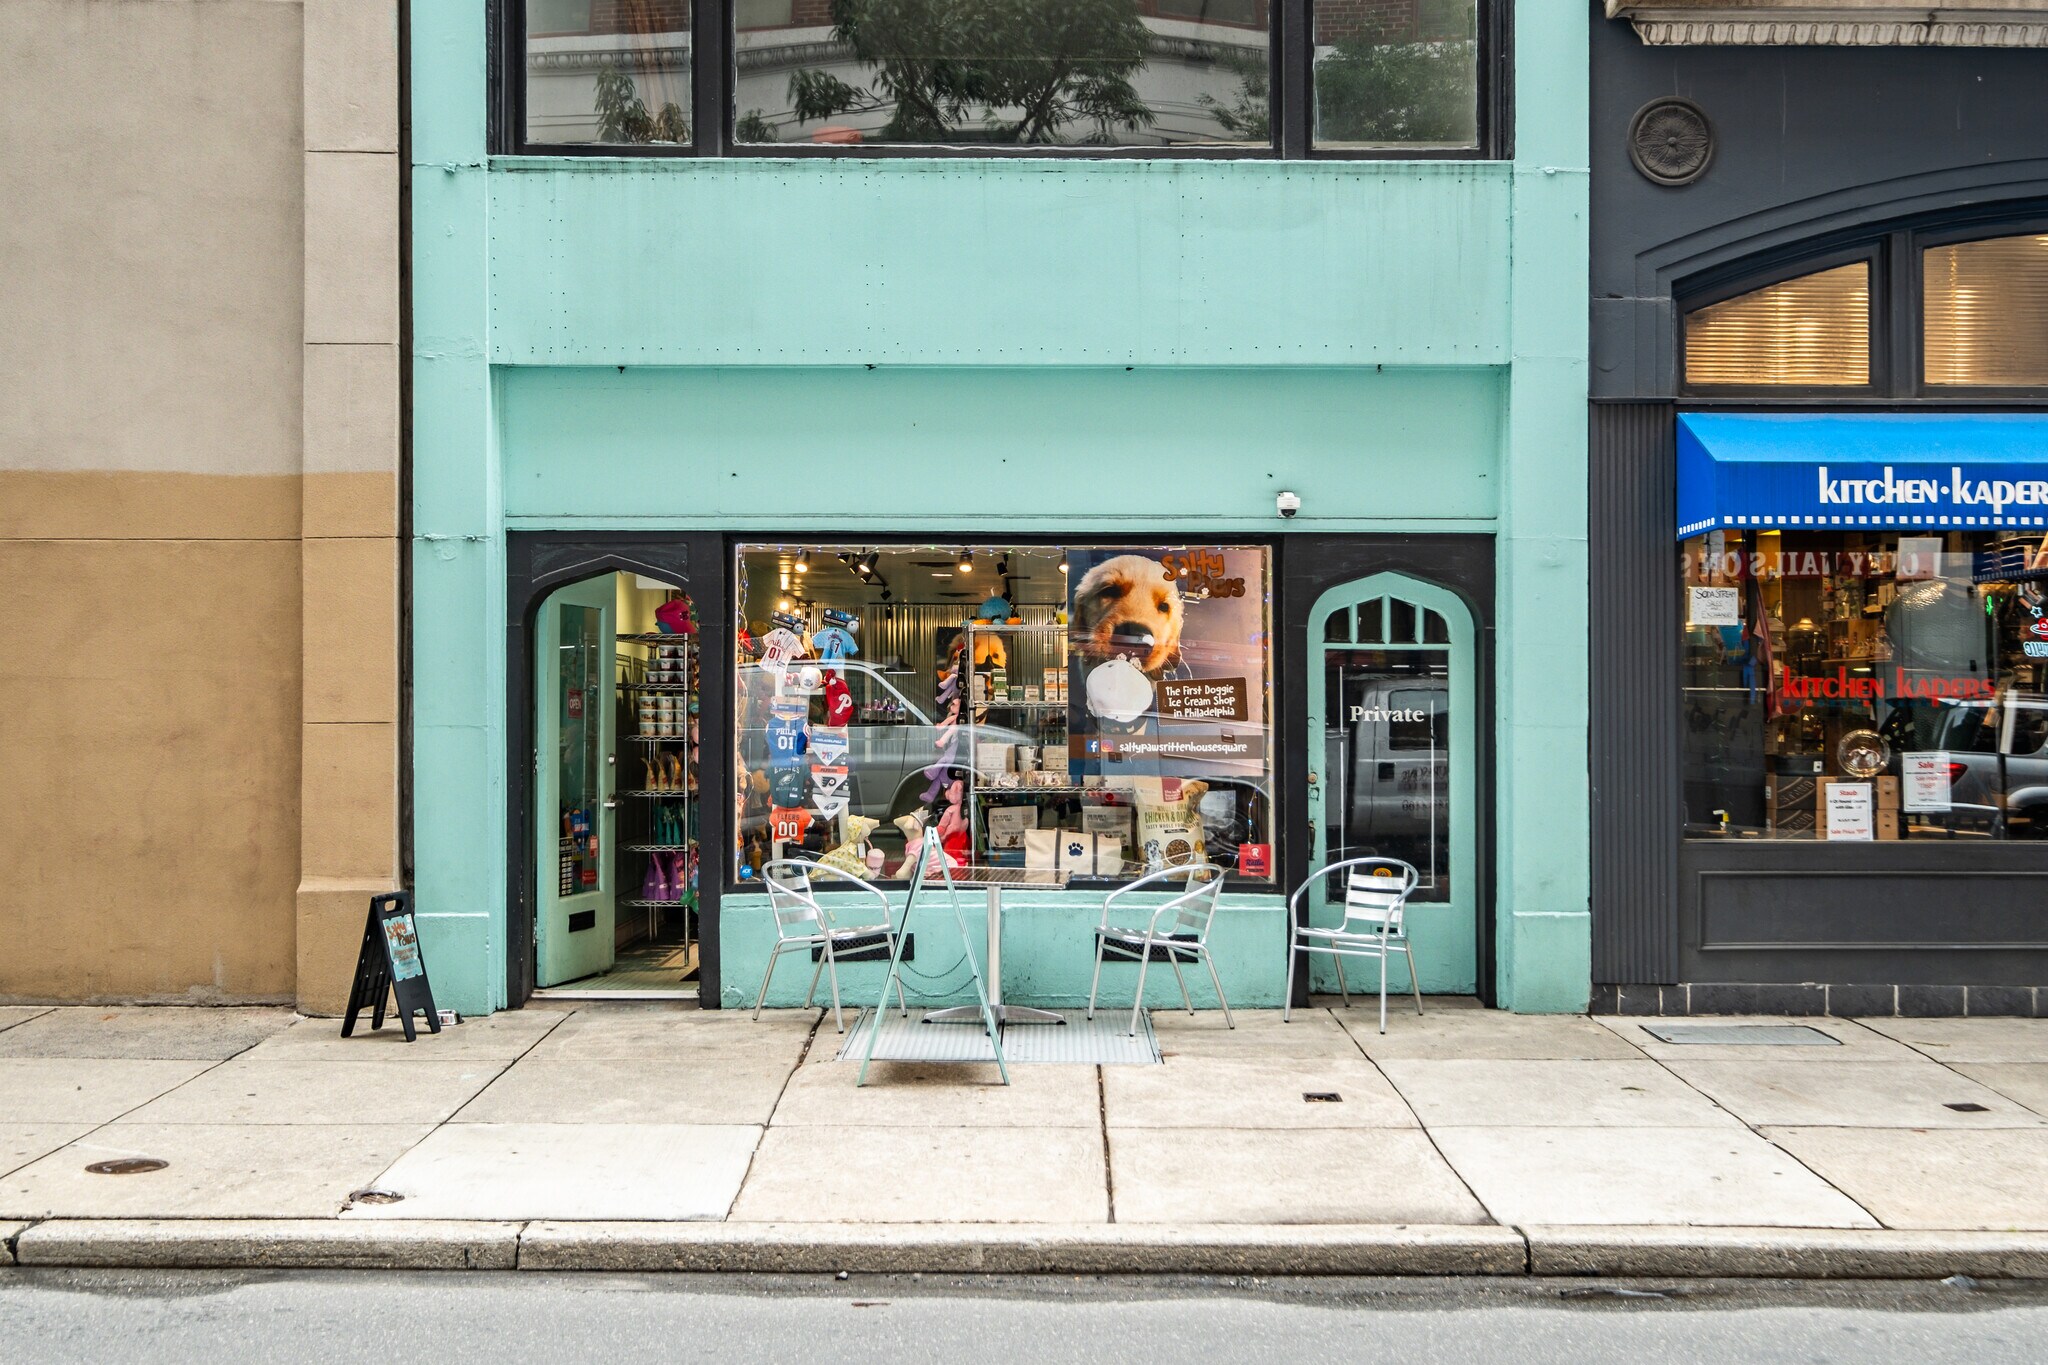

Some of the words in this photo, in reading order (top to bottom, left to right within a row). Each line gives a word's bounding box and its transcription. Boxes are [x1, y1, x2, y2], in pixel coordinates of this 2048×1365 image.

[1818, 466, 1938, 504] KITCHEN
[1161, 549, 1225, 581] Salty
[1188, 570, 1246, 598] Paws
[1165, 686, 1181, 696] The
[1183, 685, 1203, 696] First
[1205, 684, 1235, 696] Doggie
[1783, 666, 1885, 699] KITCHEN
[1896, 666, 1997, 708] KAPERS
[569, 698, 582, 710] OPEN
[1168, 697, 1182, 707] Ice
[1184, 696, 1211, 707] Cream
[1213, 695, 1236, 706] Shop
[1173, 708, 1183, 718] in
[1184, 706, 1236, 718] Philadelphia
[1349, 705, 1425, 722] Private
[778, 736, 794, 750] 01
[1119, 741, 1248, 755] saltypawsrittenhousesquare
[821, 751, 833, 760] 76
[1917, 761, 1935, 769] Sale
[1144, 811, 1170, 824] CHICKEN
[1171, 811, 1176, 823] &
[778, 821, 798, 837] 00
